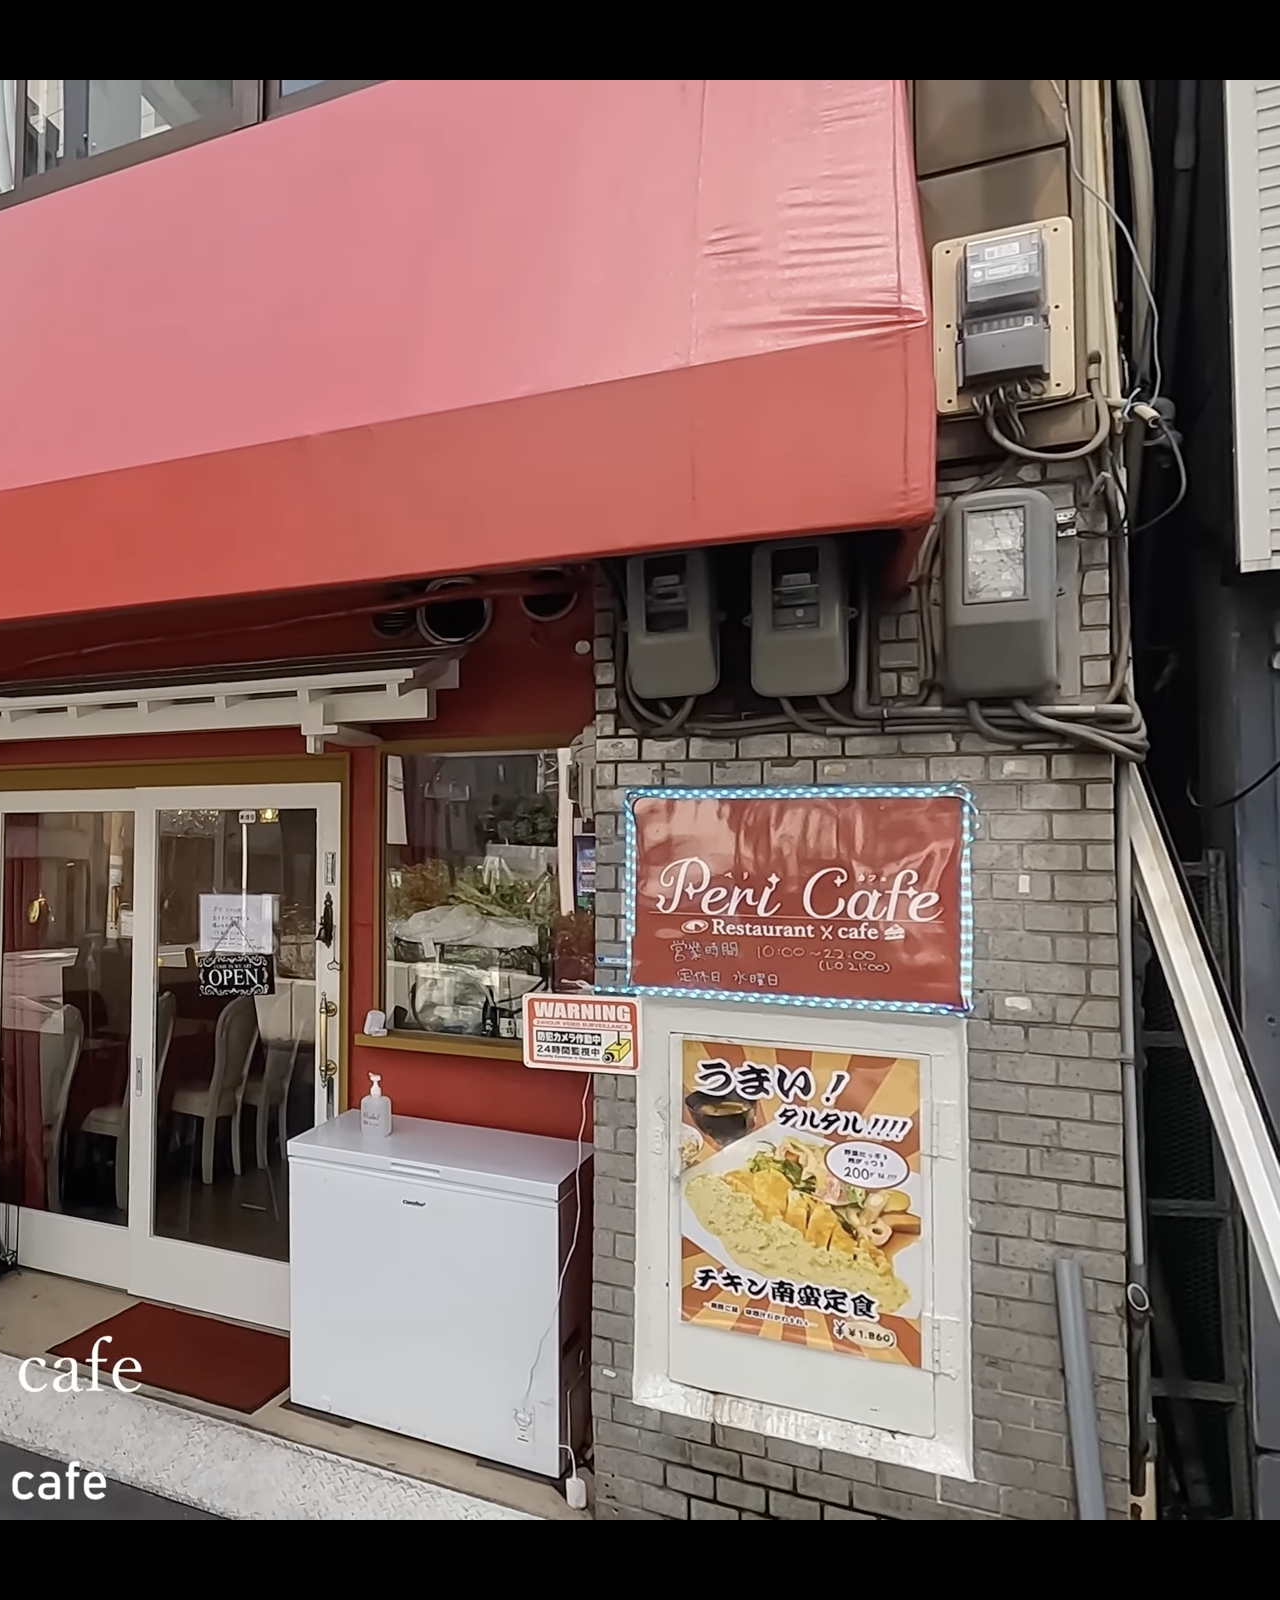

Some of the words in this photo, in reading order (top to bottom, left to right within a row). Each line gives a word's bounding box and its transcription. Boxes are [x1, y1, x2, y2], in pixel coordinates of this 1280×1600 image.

[656, 857, 781, 917] Peri
[803, 867, 945, 922] Cafe
[711, 918, 815, 939] Restaurant
[837, 922, 879, 940] cafe
[670, 940, 739, 962] 営業時間
[208, 968, 258, 986] OPEN
[676, 968, 721, 983] 定休日
[732, 970, 778, 987] 水曜日
[533, 1001, 631, 1022] WARNING
[582, 1022, 629, 1030] SURVEILLANCE
[536, 1031, 602, 1045] 防犯カメラ作動中
[536, 1044, 600, 1057] 24時間監視中
[698, 1062, 846, 1103] うまい！
[694, 1269, 878, 1319] チキン南蛮定食
